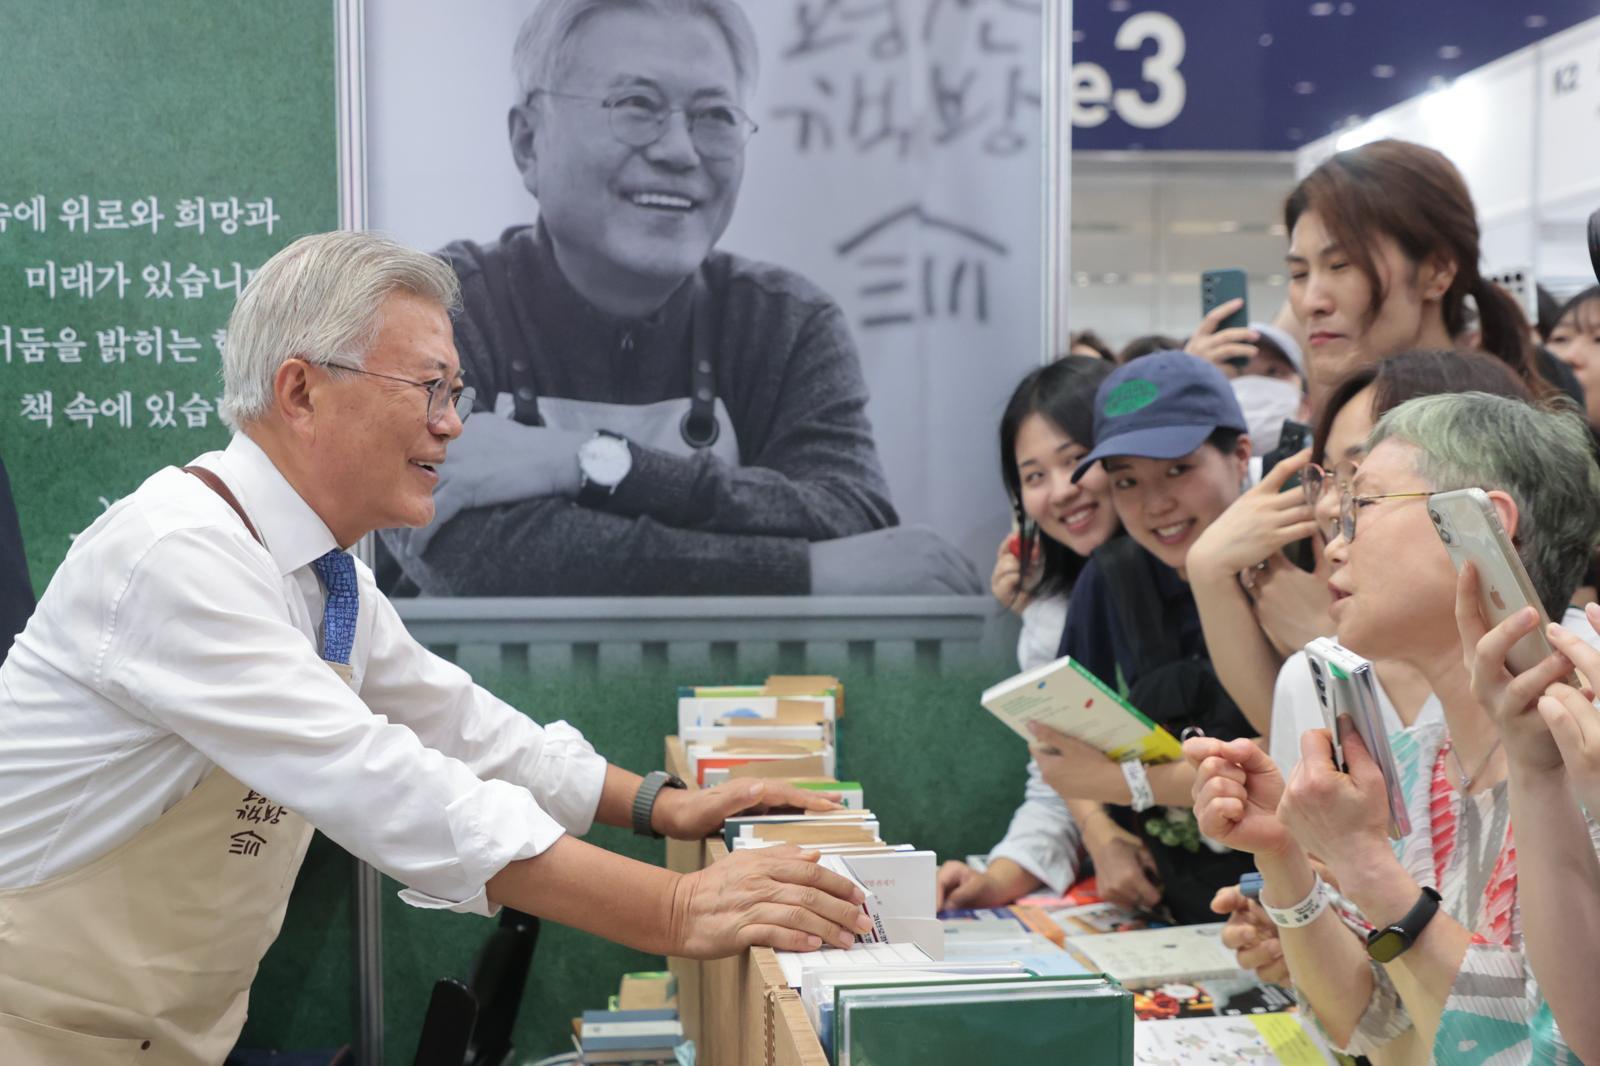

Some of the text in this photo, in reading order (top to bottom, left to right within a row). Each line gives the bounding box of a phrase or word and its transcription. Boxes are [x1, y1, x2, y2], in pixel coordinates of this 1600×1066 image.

[58, 195, 165, 235] 위로와
[174, 196, 281, 236] 희망과
[24, 260, 131, 300] 미래가
[95, 326, 202, 365] 밝히는
[19, 390, 226, 429] 책 속에 있습
